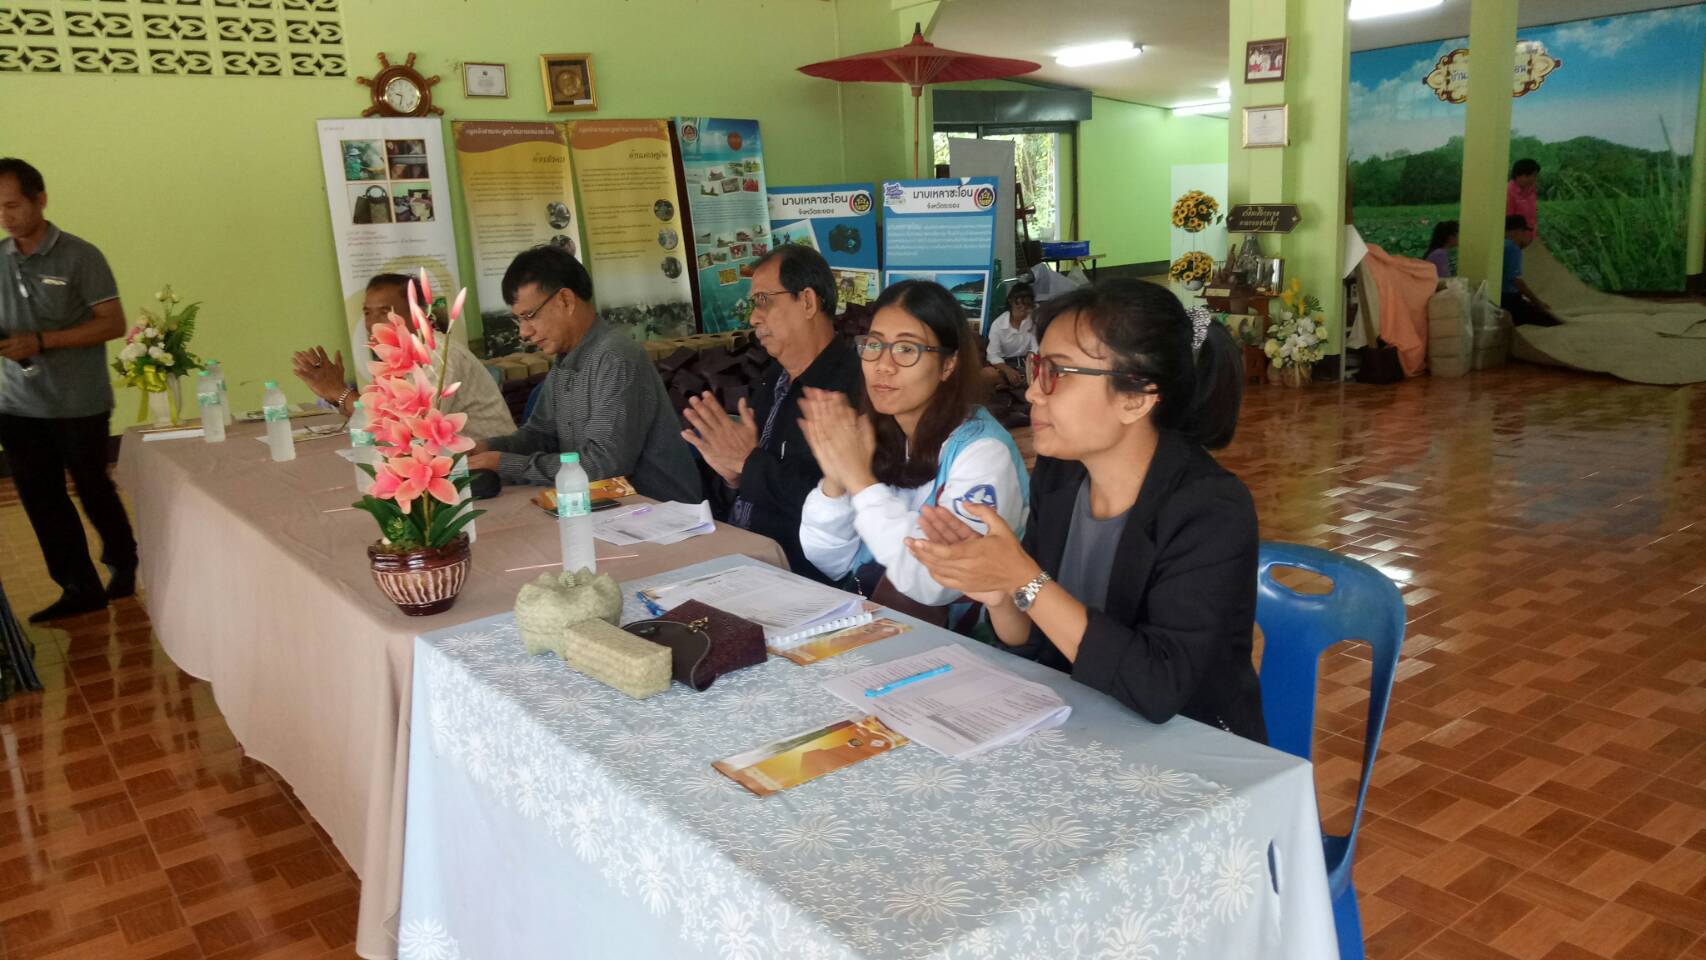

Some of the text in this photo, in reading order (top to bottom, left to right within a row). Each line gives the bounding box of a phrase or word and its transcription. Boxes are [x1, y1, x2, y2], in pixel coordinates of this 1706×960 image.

[782, 192, 848, 206] มาบเหลาชะโอน
[799, 207, 835, 215] จังหวัดระยอง
